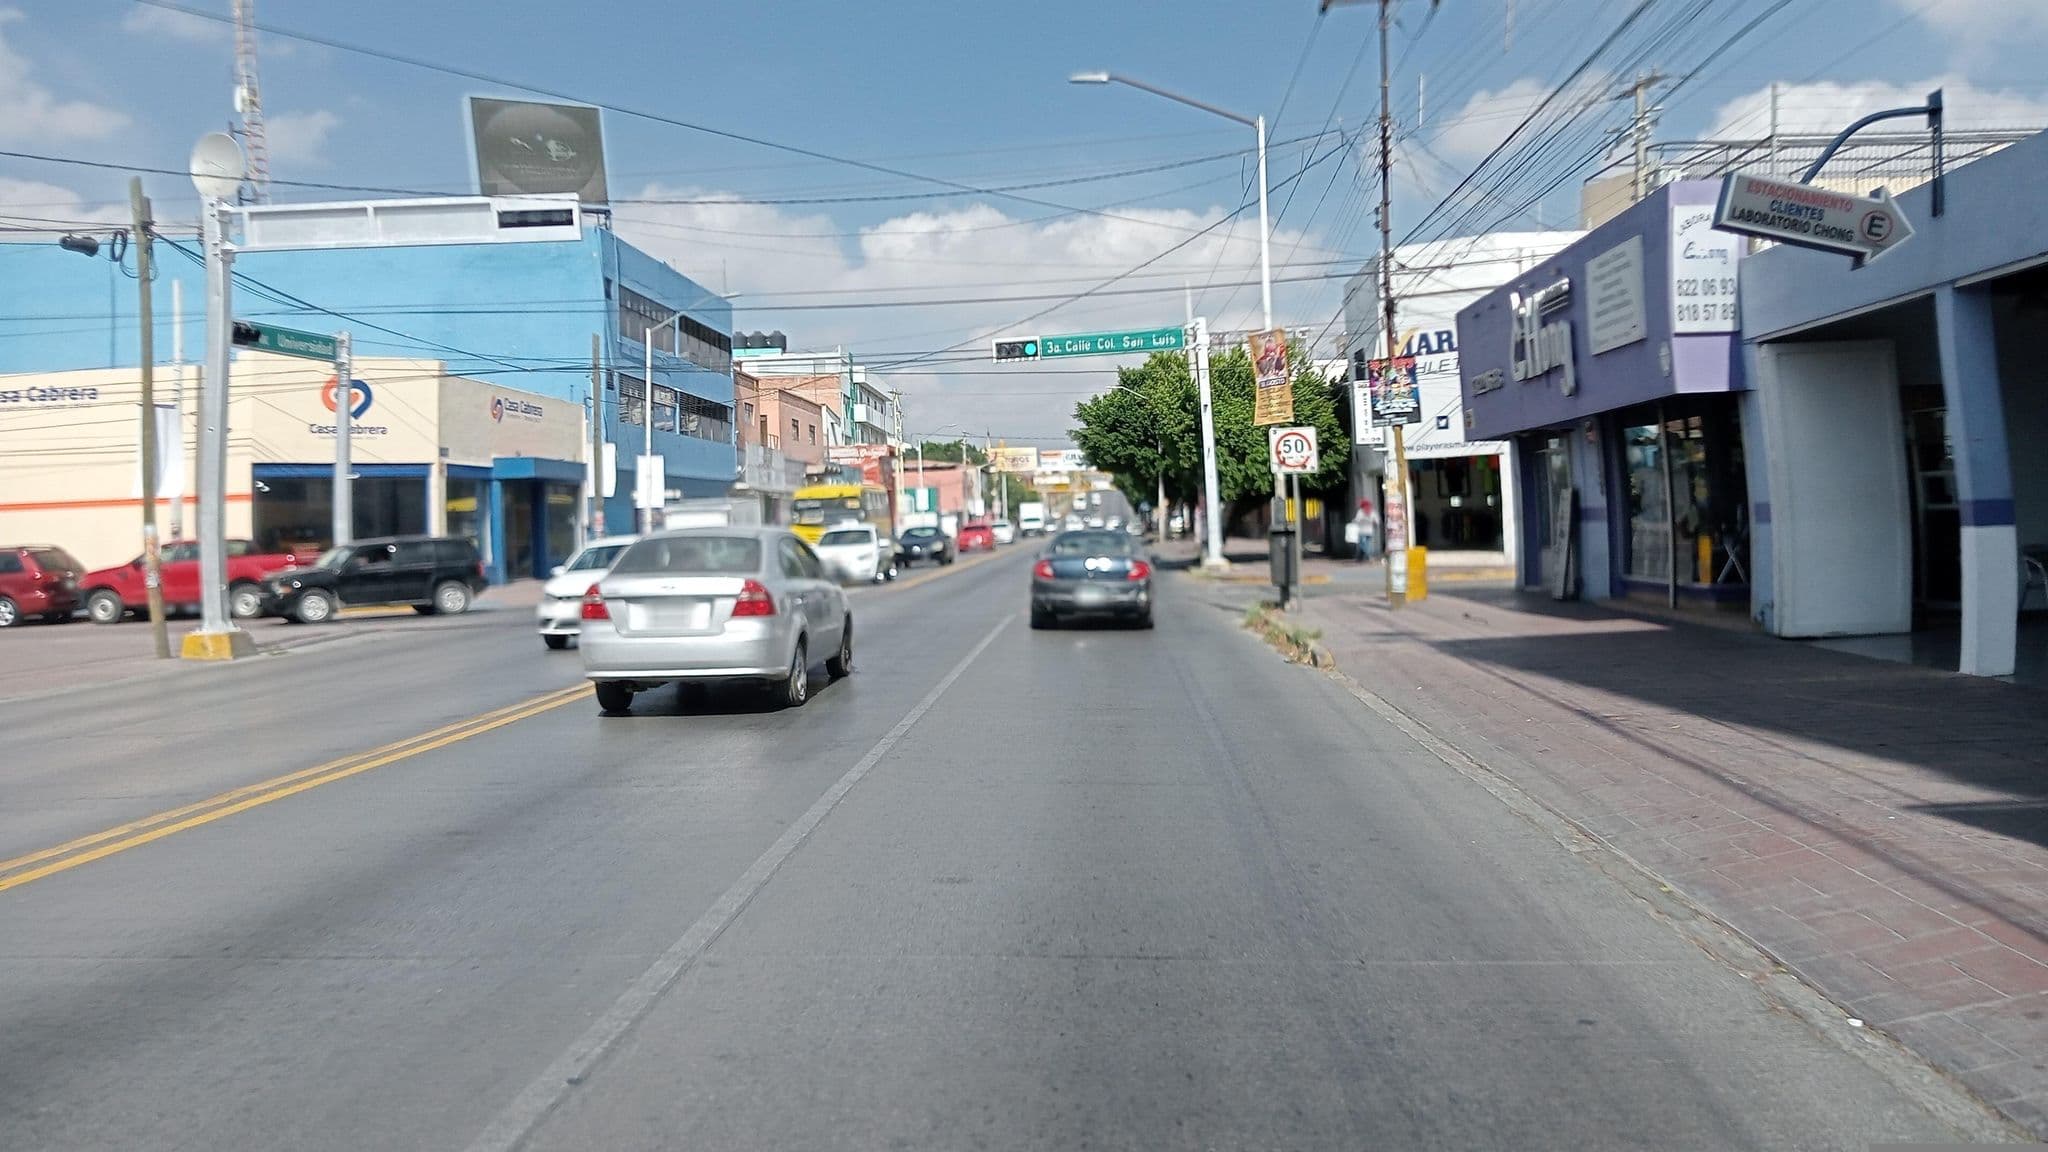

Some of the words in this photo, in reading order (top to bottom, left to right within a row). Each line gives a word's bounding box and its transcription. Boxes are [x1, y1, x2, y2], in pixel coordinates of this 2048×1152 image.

[1747, 179, 1854, 213] ESTACIONAMIENTO
[1770, 199, 1825, 221] CLIENTES
[1732, 206, 1811, 233] LABORATORIO
[1814, 223, 1855, 242] CHONG
[1867, 214, 1886, 238] E
[1677, 279, 1699, 296] 822
[1720, 278, 1736, 296] 93
[1677, 303, 1699, 321] 818
[1703, 304, 1717, 321] 57
[1065, 340, 1091, 353] Calle
[1122, 335, 1144, 349] San
[1152, 333, 1176, 347] Luis
[28, 386, 97, 402] Cabrera
[504, 397, 518, 412] Casa
[520, 400, 543, 417] Cabrera
[1283, 439, 1304, 454] 50
